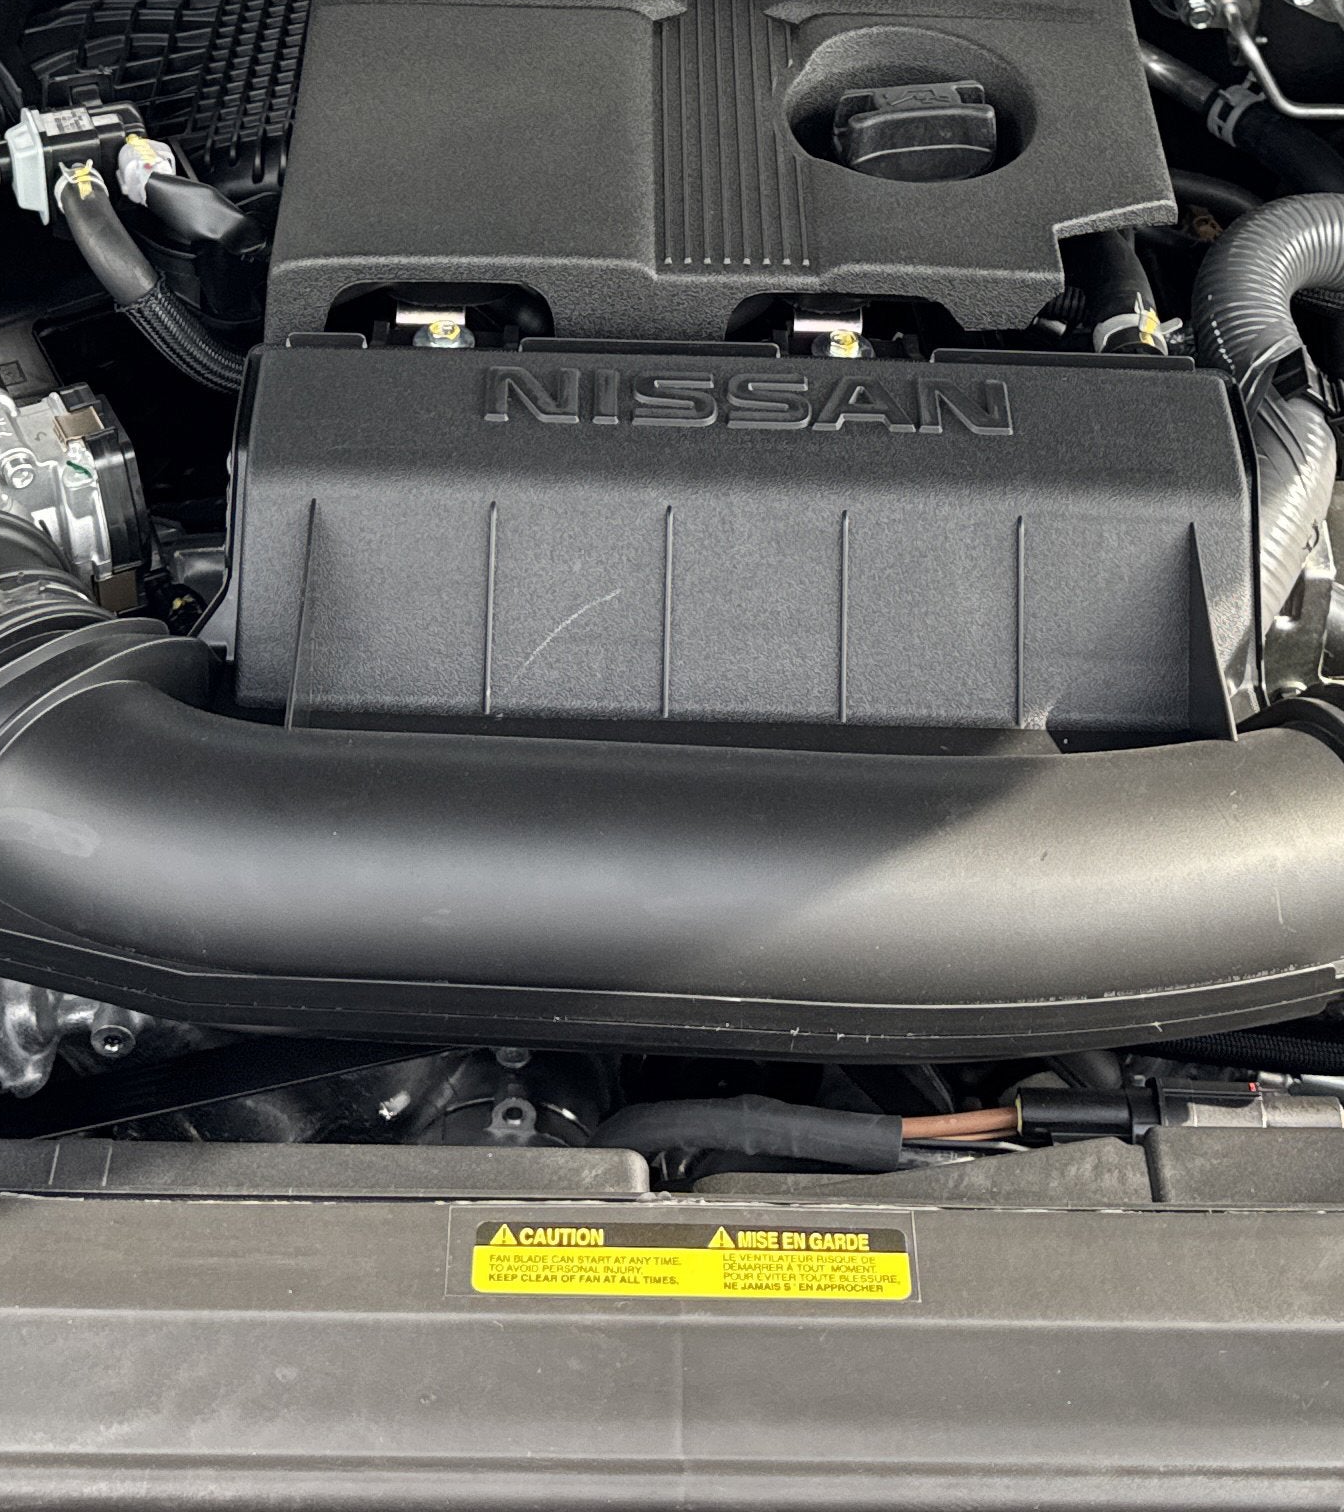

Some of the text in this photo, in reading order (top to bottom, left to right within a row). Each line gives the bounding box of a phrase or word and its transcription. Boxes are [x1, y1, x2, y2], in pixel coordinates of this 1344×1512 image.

[484, 365, 1014, 436] NISSAN
[519, 1227, 604, 1246] CAUTION
[738, 1231, 869, 1251] MISE EN GARDE
[489, 1255, 511, 1263] FAN
[513, 1255, 548, 1263] BLADE
[551, 1255, 574, 1264] CAN
[578, 1255, 610, 1264] START
[614, 1256, 626, 1264] AT
[628, 1256, 650, 1265] ANY
[723, 1254, 875, 1264] LE VENTILATEUR RISQUE DE
[489, 1264, 504, 1272] TO
[506, 1264, 538, 1273] AVOID
[543, 1265, 599, 1274] PERSONAL
[798, 1264, 825, 1273] TOUT
[489, 1274, 518, 1282] KEEP
[520, 1274, 558, 1282] CLEAR
[561, 1274, 574, 1283] OF
[579, 1275, 600, 1283] FAN
[604, 1275, 616, 1284] AT
[619, 1275, 640, 1284] ALL
[800, 1274, 835, 1282] TOUTE
[741, 1283, 780, 1291] JAMAIS
[816, 1284, 883, 1292] APPROCHER
